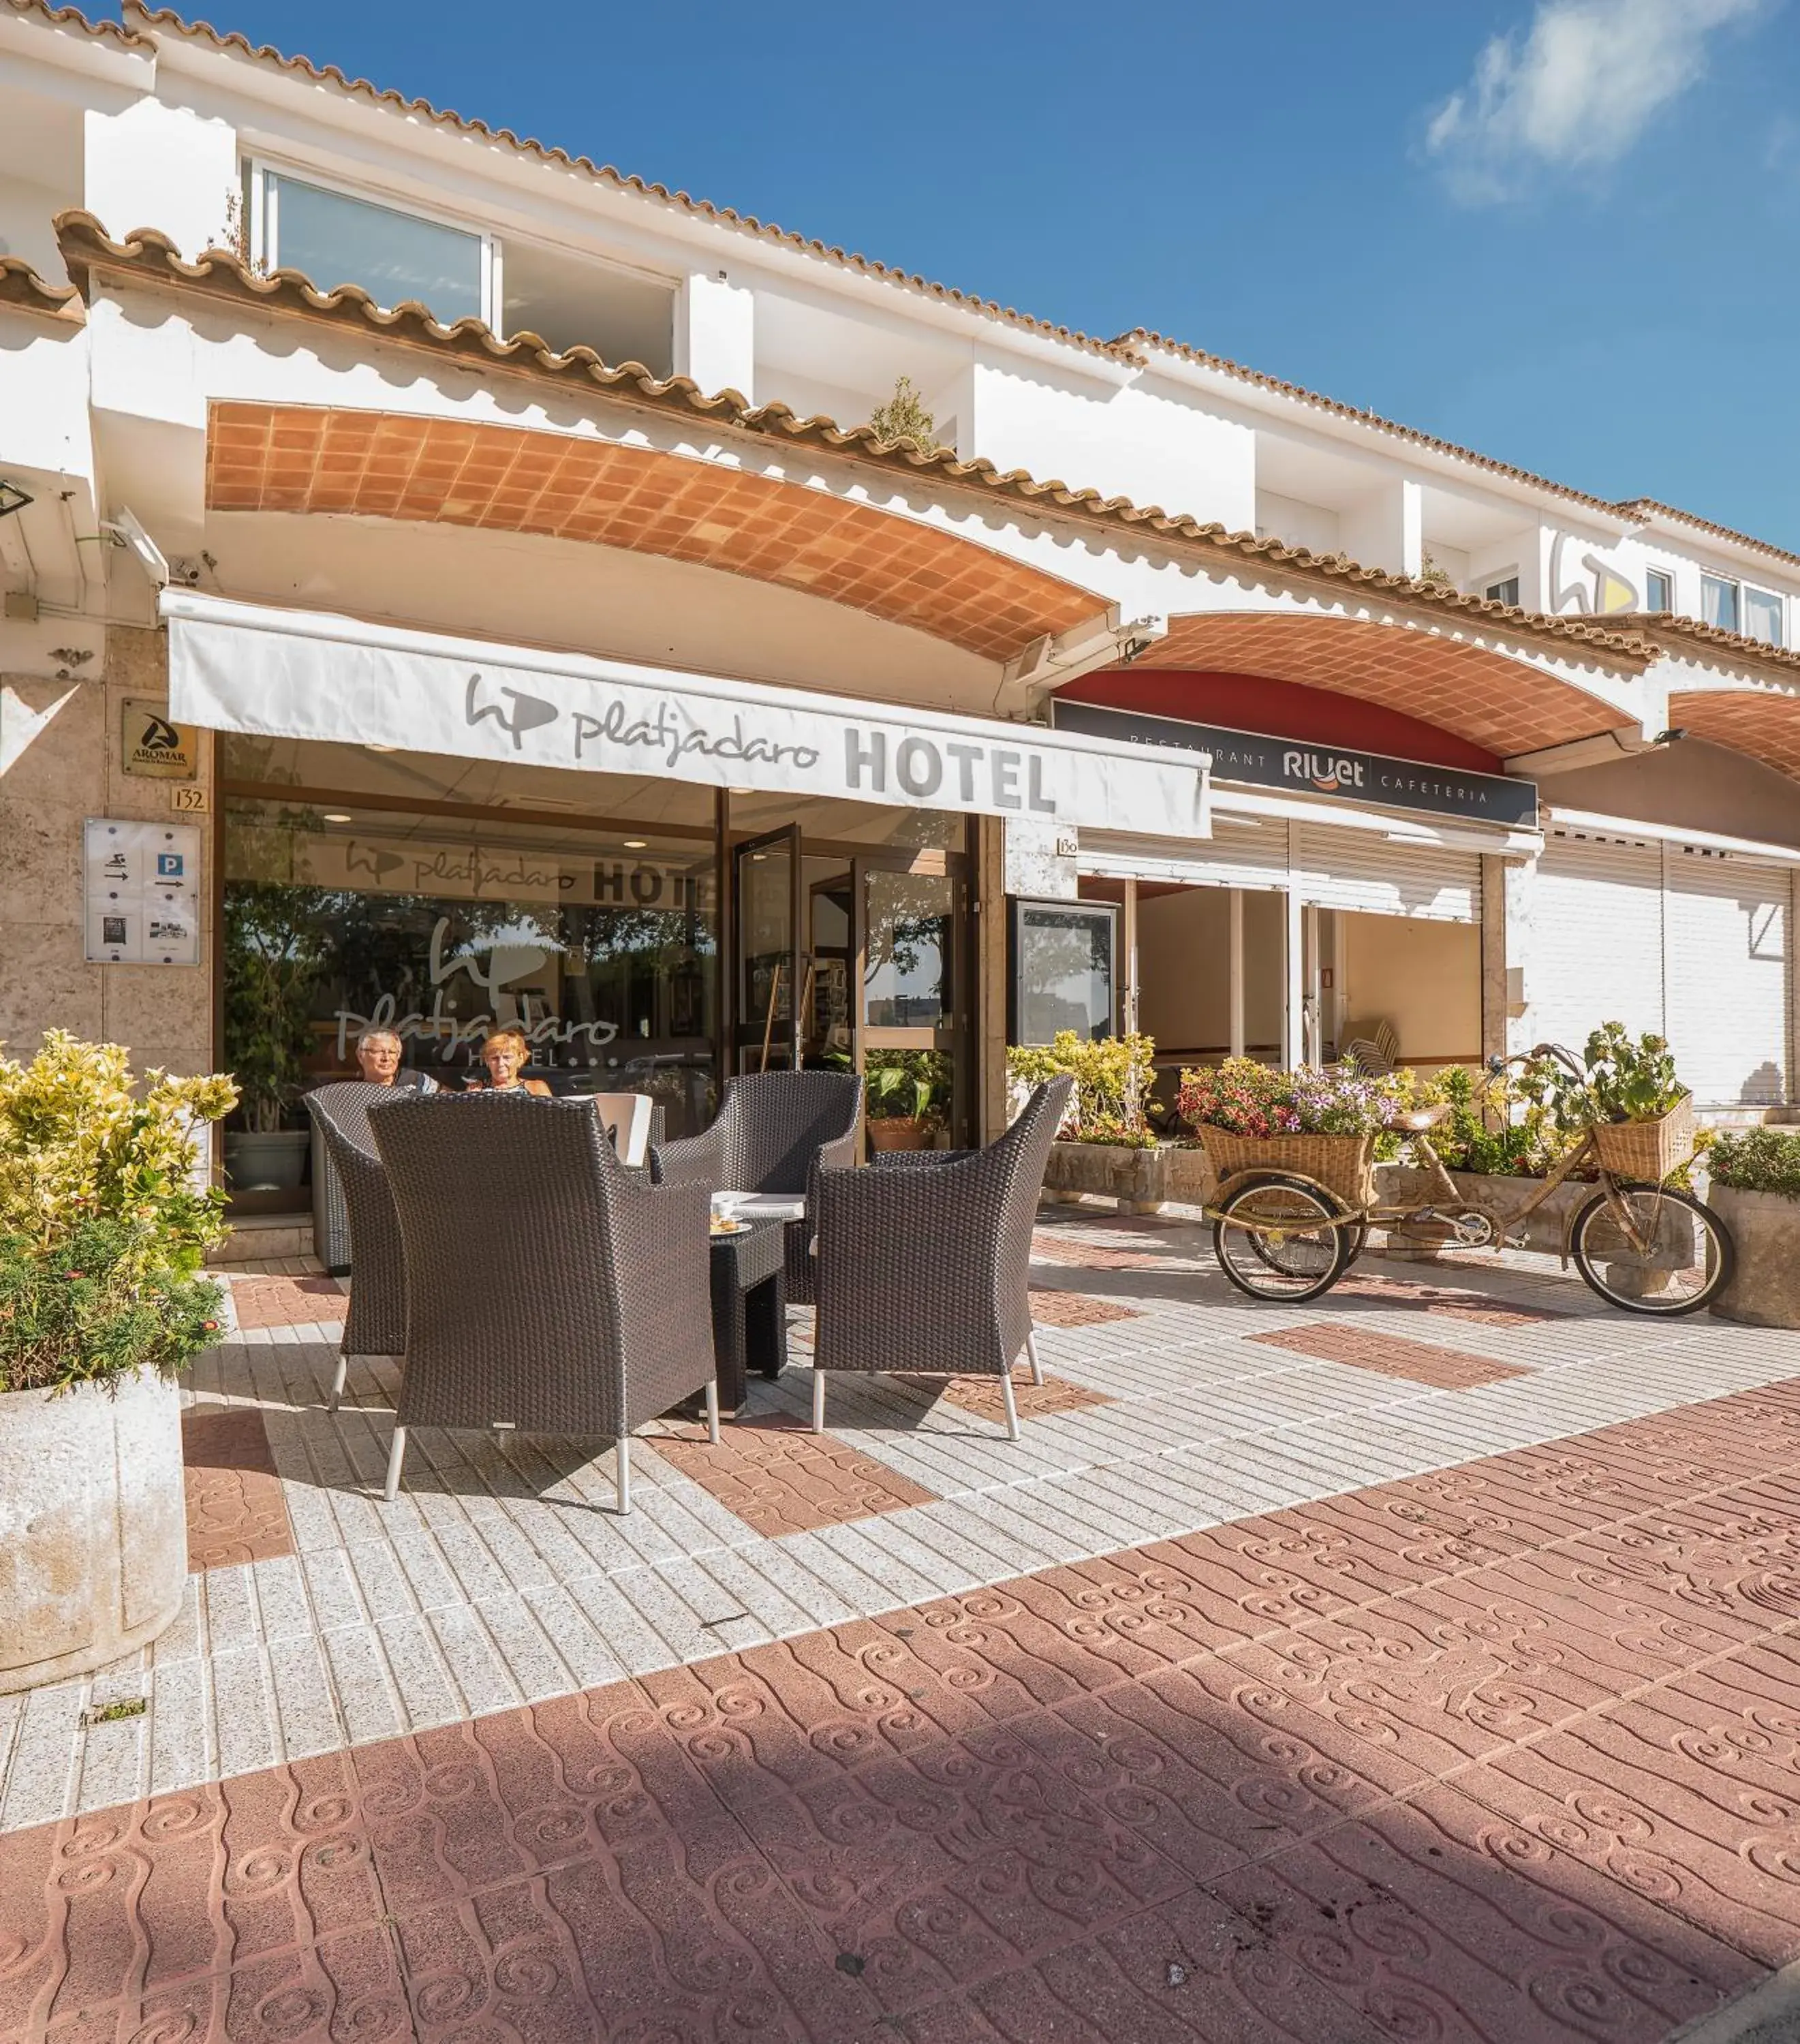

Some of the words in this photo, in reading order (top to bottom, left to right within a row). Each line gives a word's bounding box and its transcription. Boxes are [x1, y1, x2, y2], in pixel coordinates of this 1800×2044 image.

[133, 749, 187, 762] AROMAR
[572, 700, 820, 767] platjadaro
[844, 727, 1056, 814] HOTEL
[177, 788, 204, 809] 132
[1380, 775, 1487, 803] CAFETERIA
[468, 1049, 558, 1067] HEL
